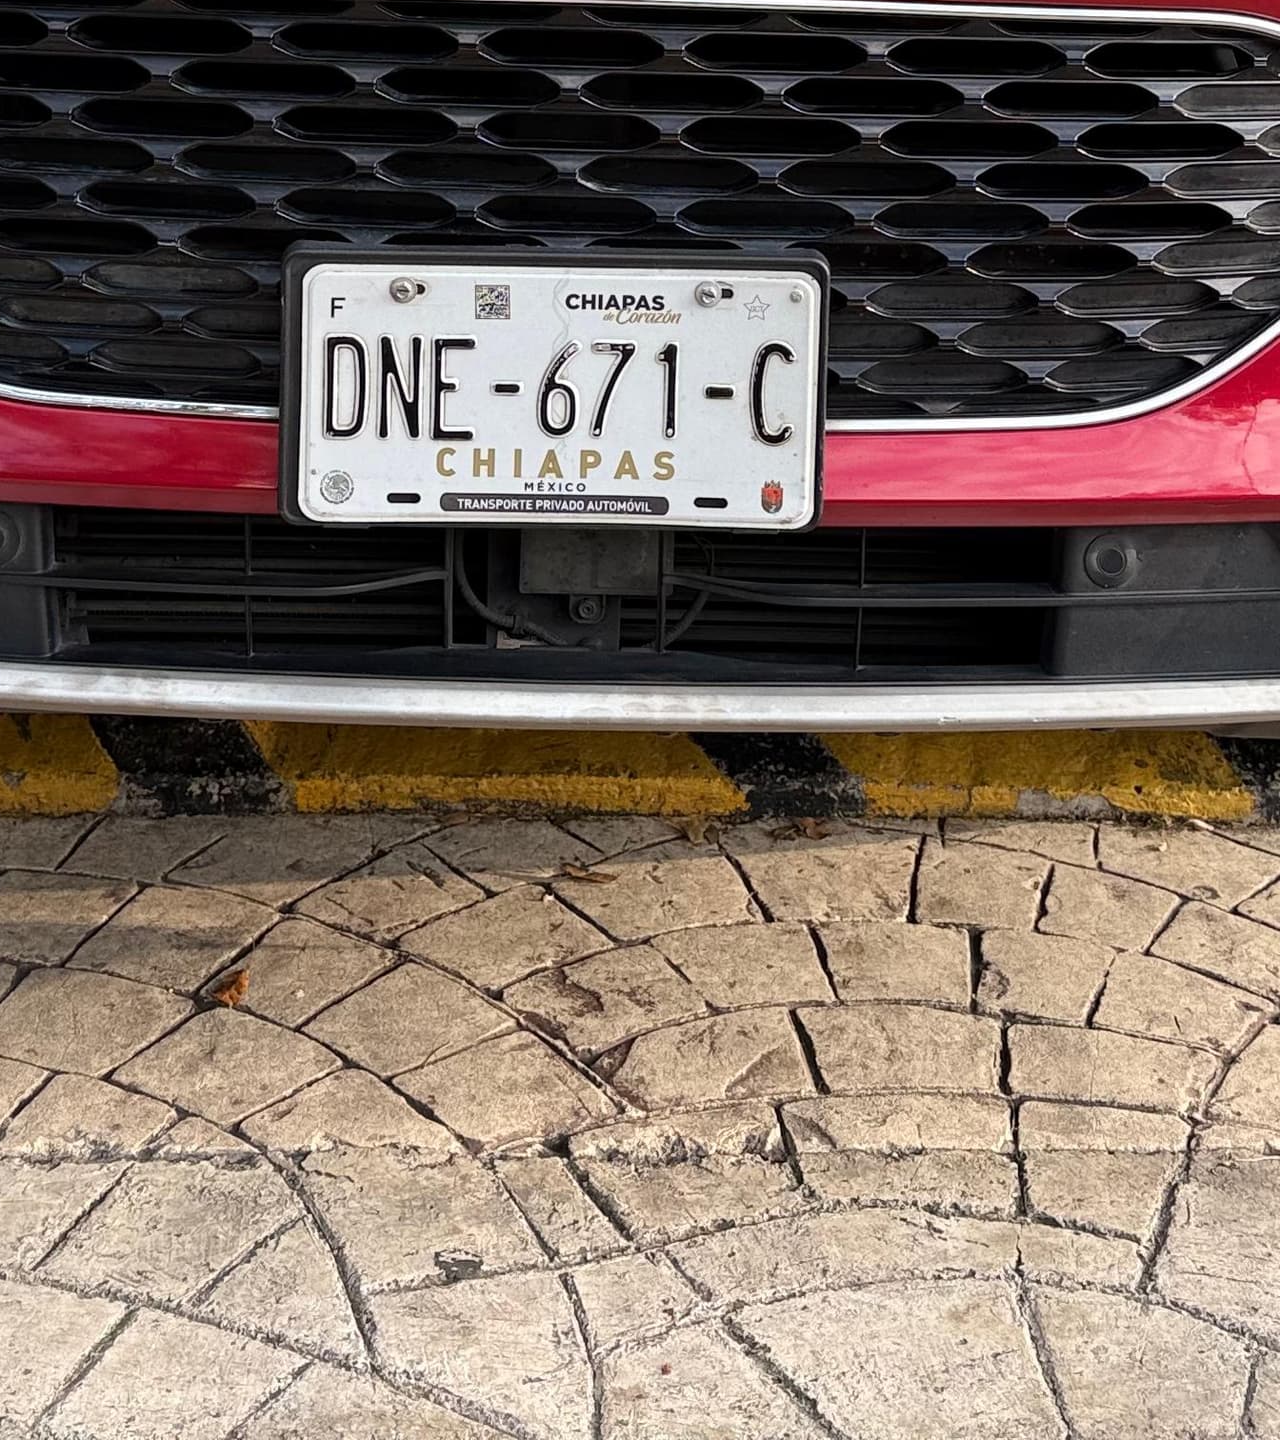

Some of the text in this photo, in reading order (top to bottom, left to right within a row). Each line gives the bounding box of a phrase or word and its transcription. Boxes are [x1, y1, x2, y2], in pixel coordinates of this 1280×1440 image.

[329, 297, 346, 319] F
[565, 293, 666, 312] CHIAPAS
[603, 308, 683, 326] de Corazón
[322, 335, 797, 447] DNE-671-C
[435, 447, 677, 481] CHIAPAS
[524, 479, 587, 494] MÉXICO
[457, 496, 652, 514] TRANSPORTE PRIVADO AUTOMÓVIL
